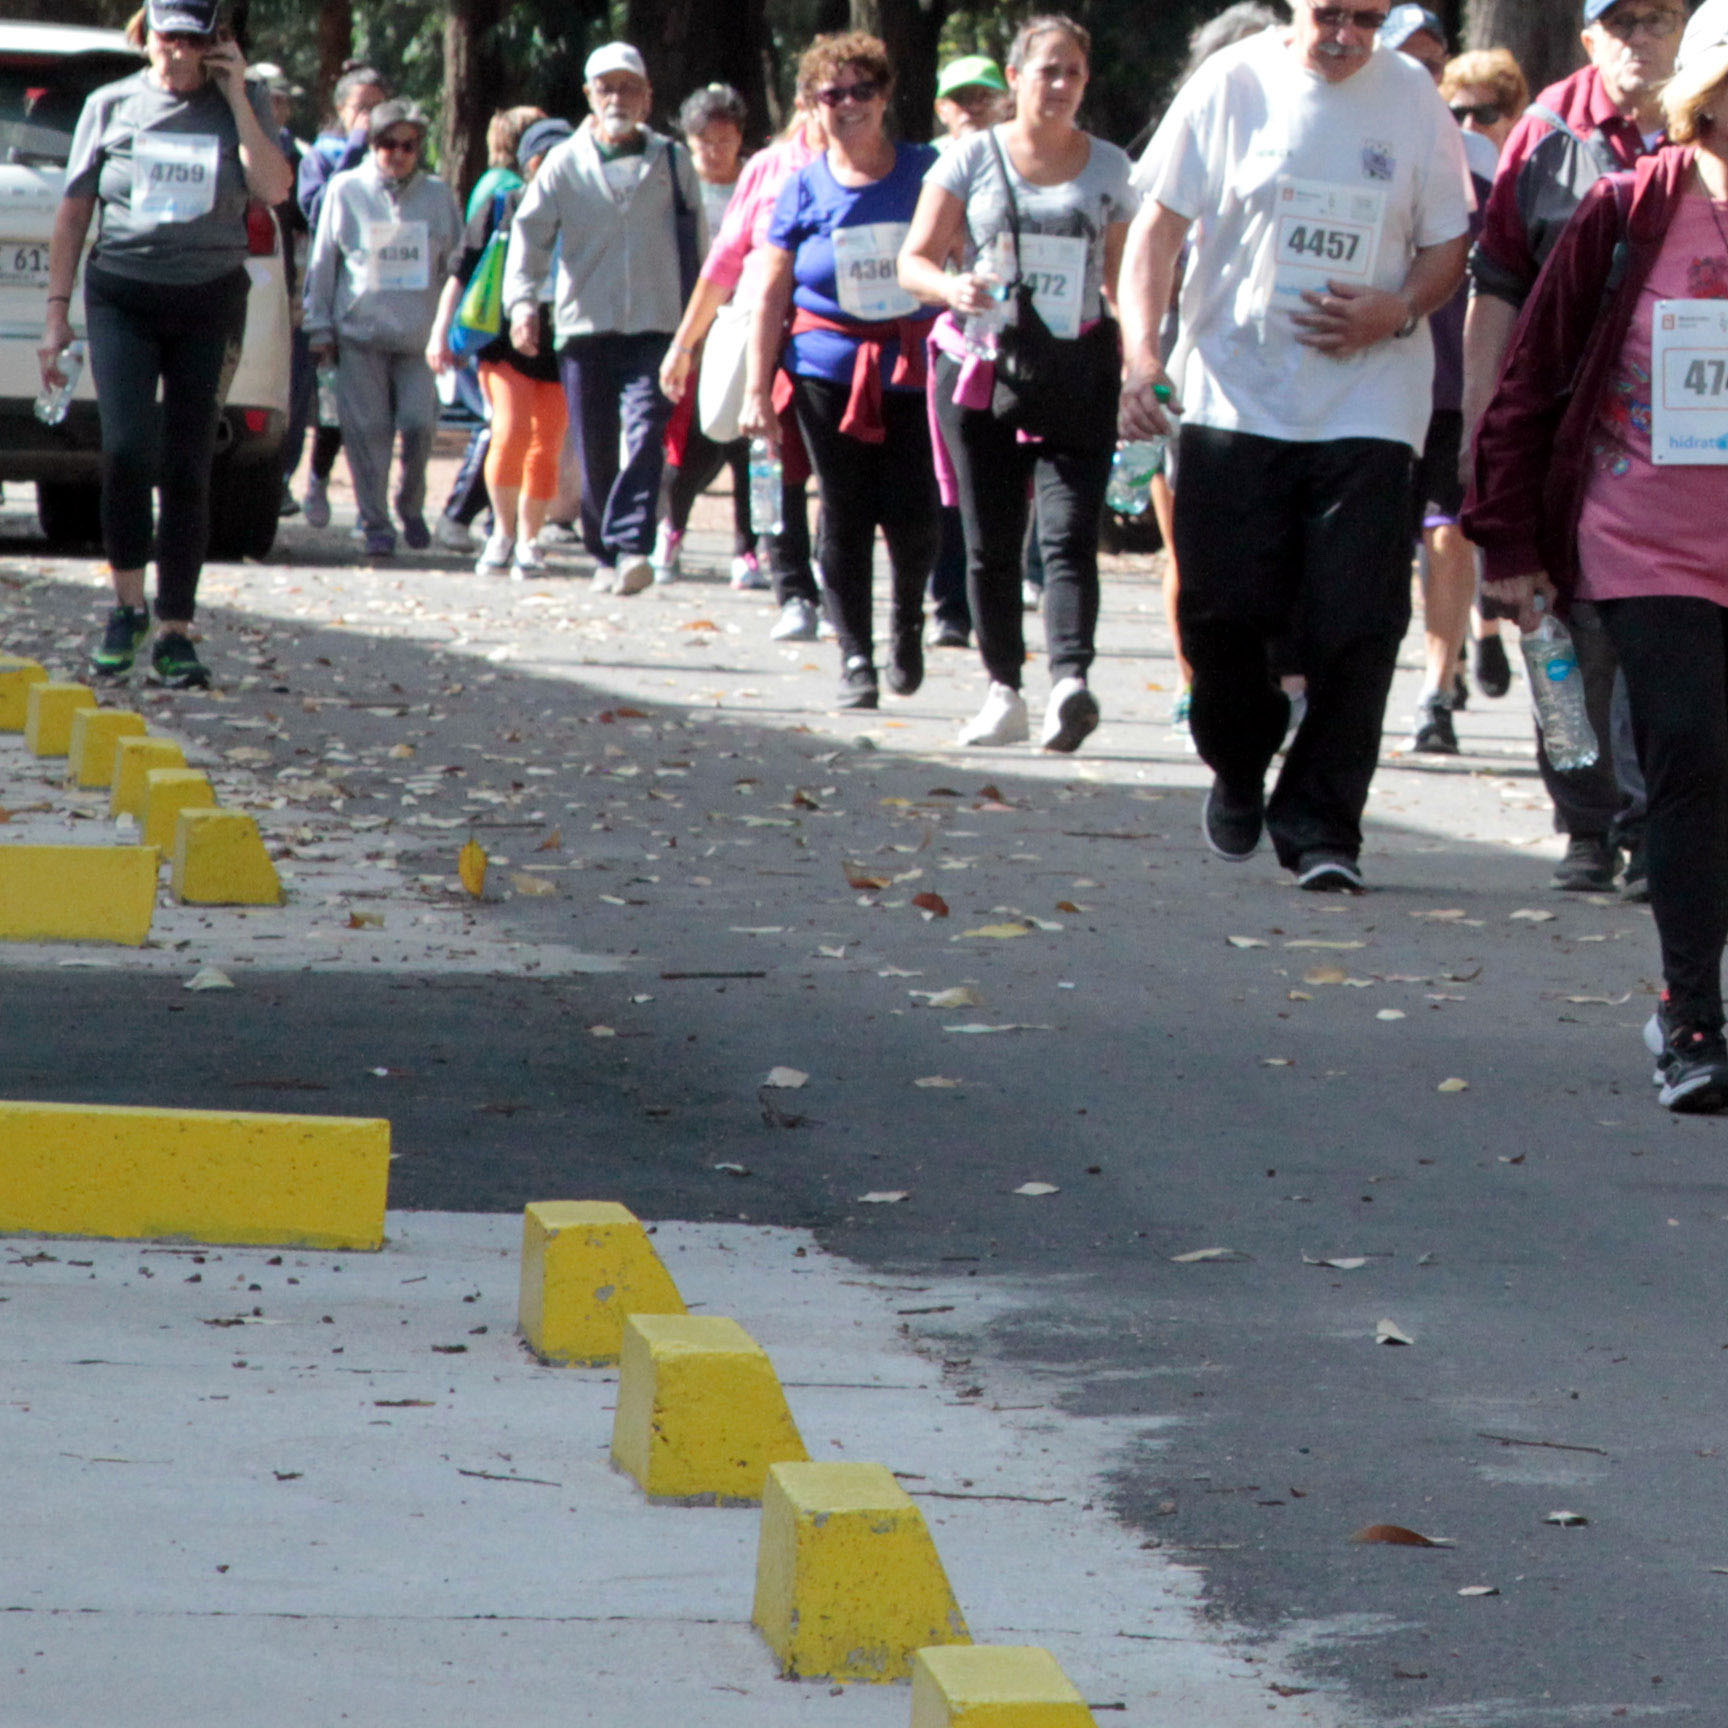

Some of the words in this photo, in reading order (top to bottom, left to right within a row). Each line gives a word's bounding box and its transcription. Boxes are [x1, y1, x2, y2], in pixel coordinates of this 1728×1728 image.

[149, 162, 205, 184] 4759
[1287, 225, 1361, 262] 4457
[849, 257, 899, 281] 438
